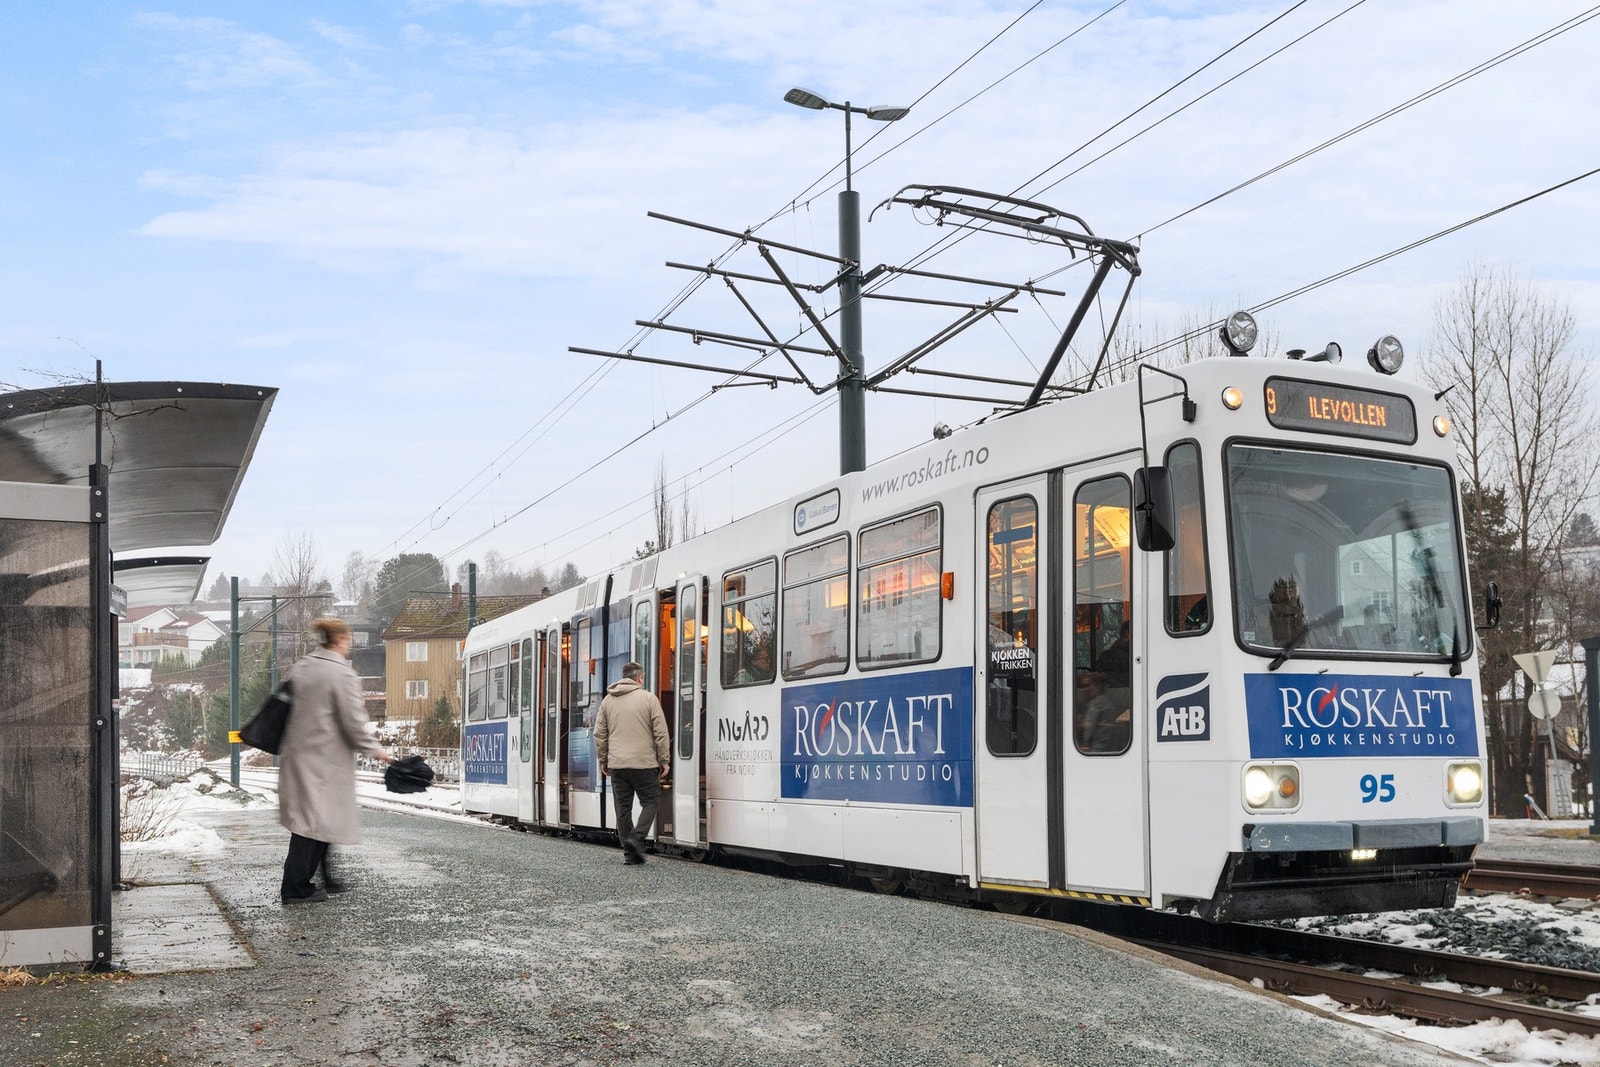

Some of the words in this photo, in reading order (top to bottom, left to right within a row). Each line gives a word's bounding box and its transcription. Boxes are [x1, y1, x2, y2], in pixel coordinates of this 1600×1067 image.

[1266, 387, 1277, 414] 9
[1309, 396, 1387, 427] ILEVOLLEN
[862, 447, 990, 503] www.roskaft.no
[1000, 660, 1033, 670] TRIKKEN
[718, 710, 769, 742] NYGÅRD
[1160, 705, 1206, 737] AtB
[1285, 733, 1456, 749] KJØKKENSTUDIO
[726, 764, 737, 776] FRA
[794, 763, 952, 784] KJØKKENSTUDIO
[1359, 774, 1396, 804] 95
